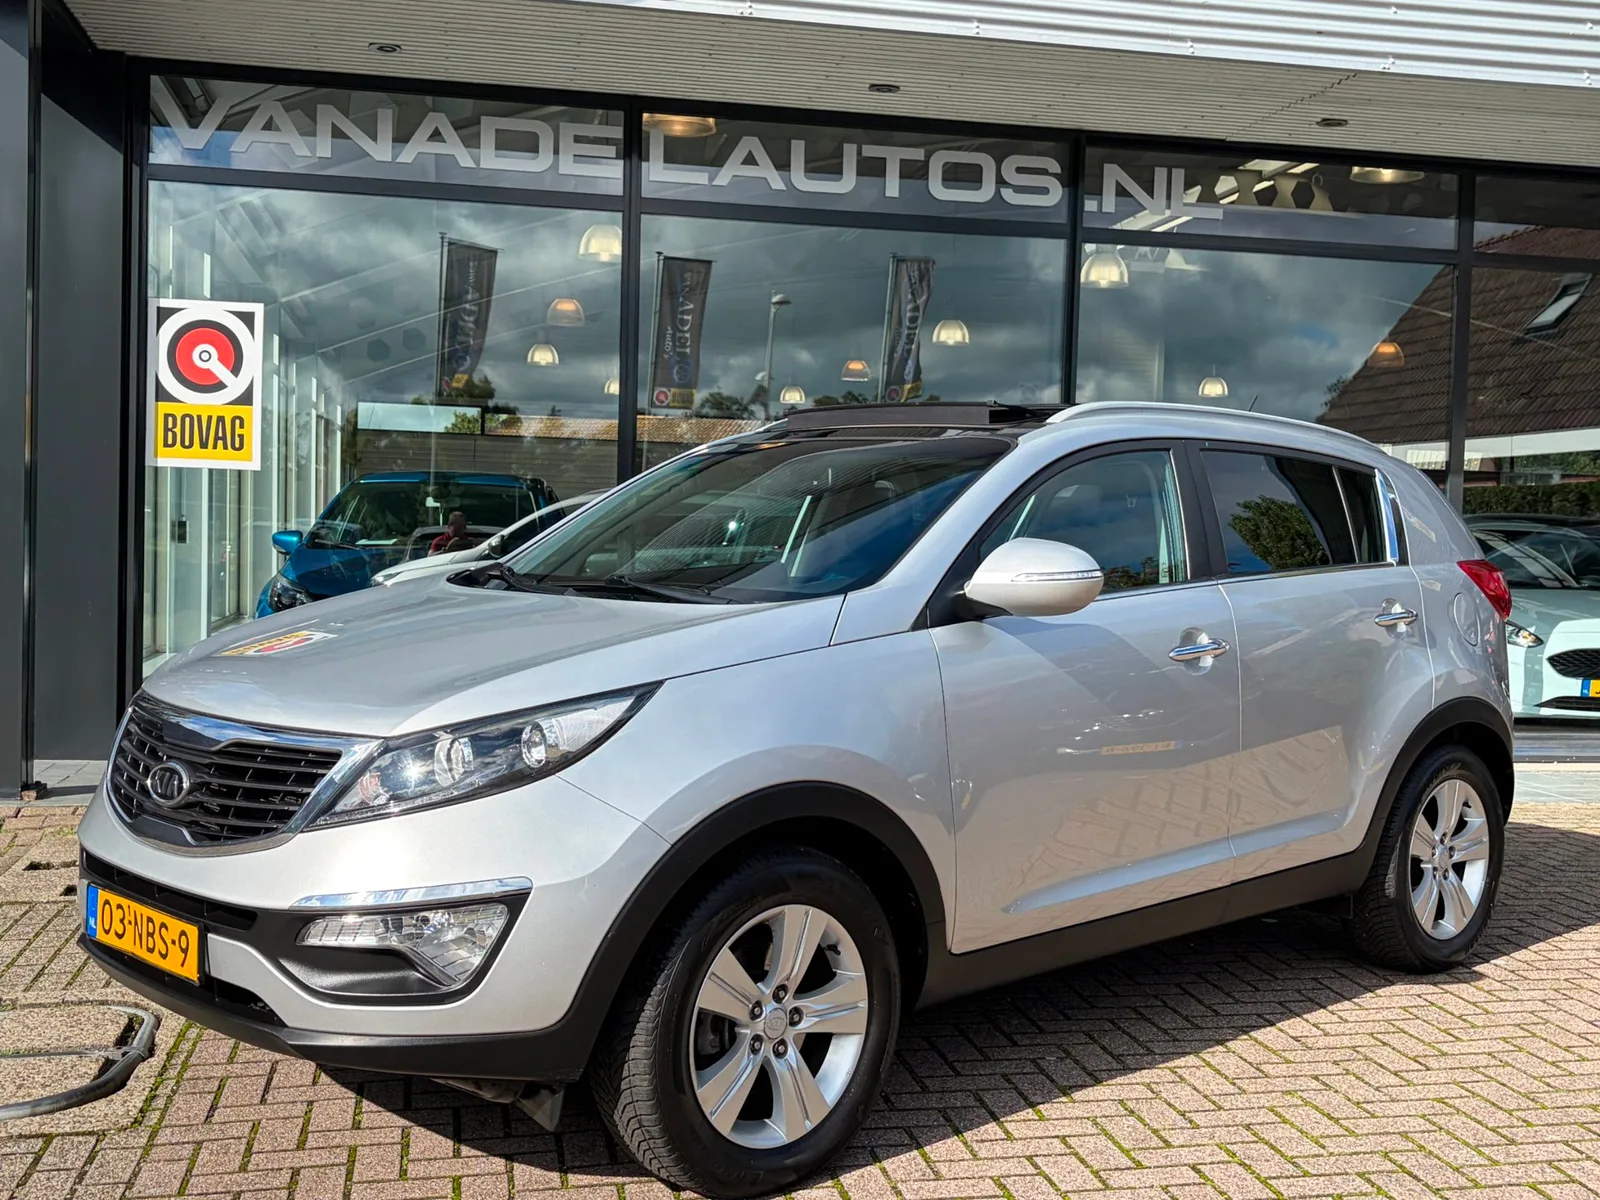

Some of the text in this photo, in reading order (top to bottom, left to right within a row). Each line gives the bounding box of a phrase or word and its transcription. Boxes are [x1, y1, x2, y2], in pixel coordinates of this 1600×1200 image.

[162, 413, 245, 452] BOVAG
[89, 898, 190, 968] NL 03-NBS-9
